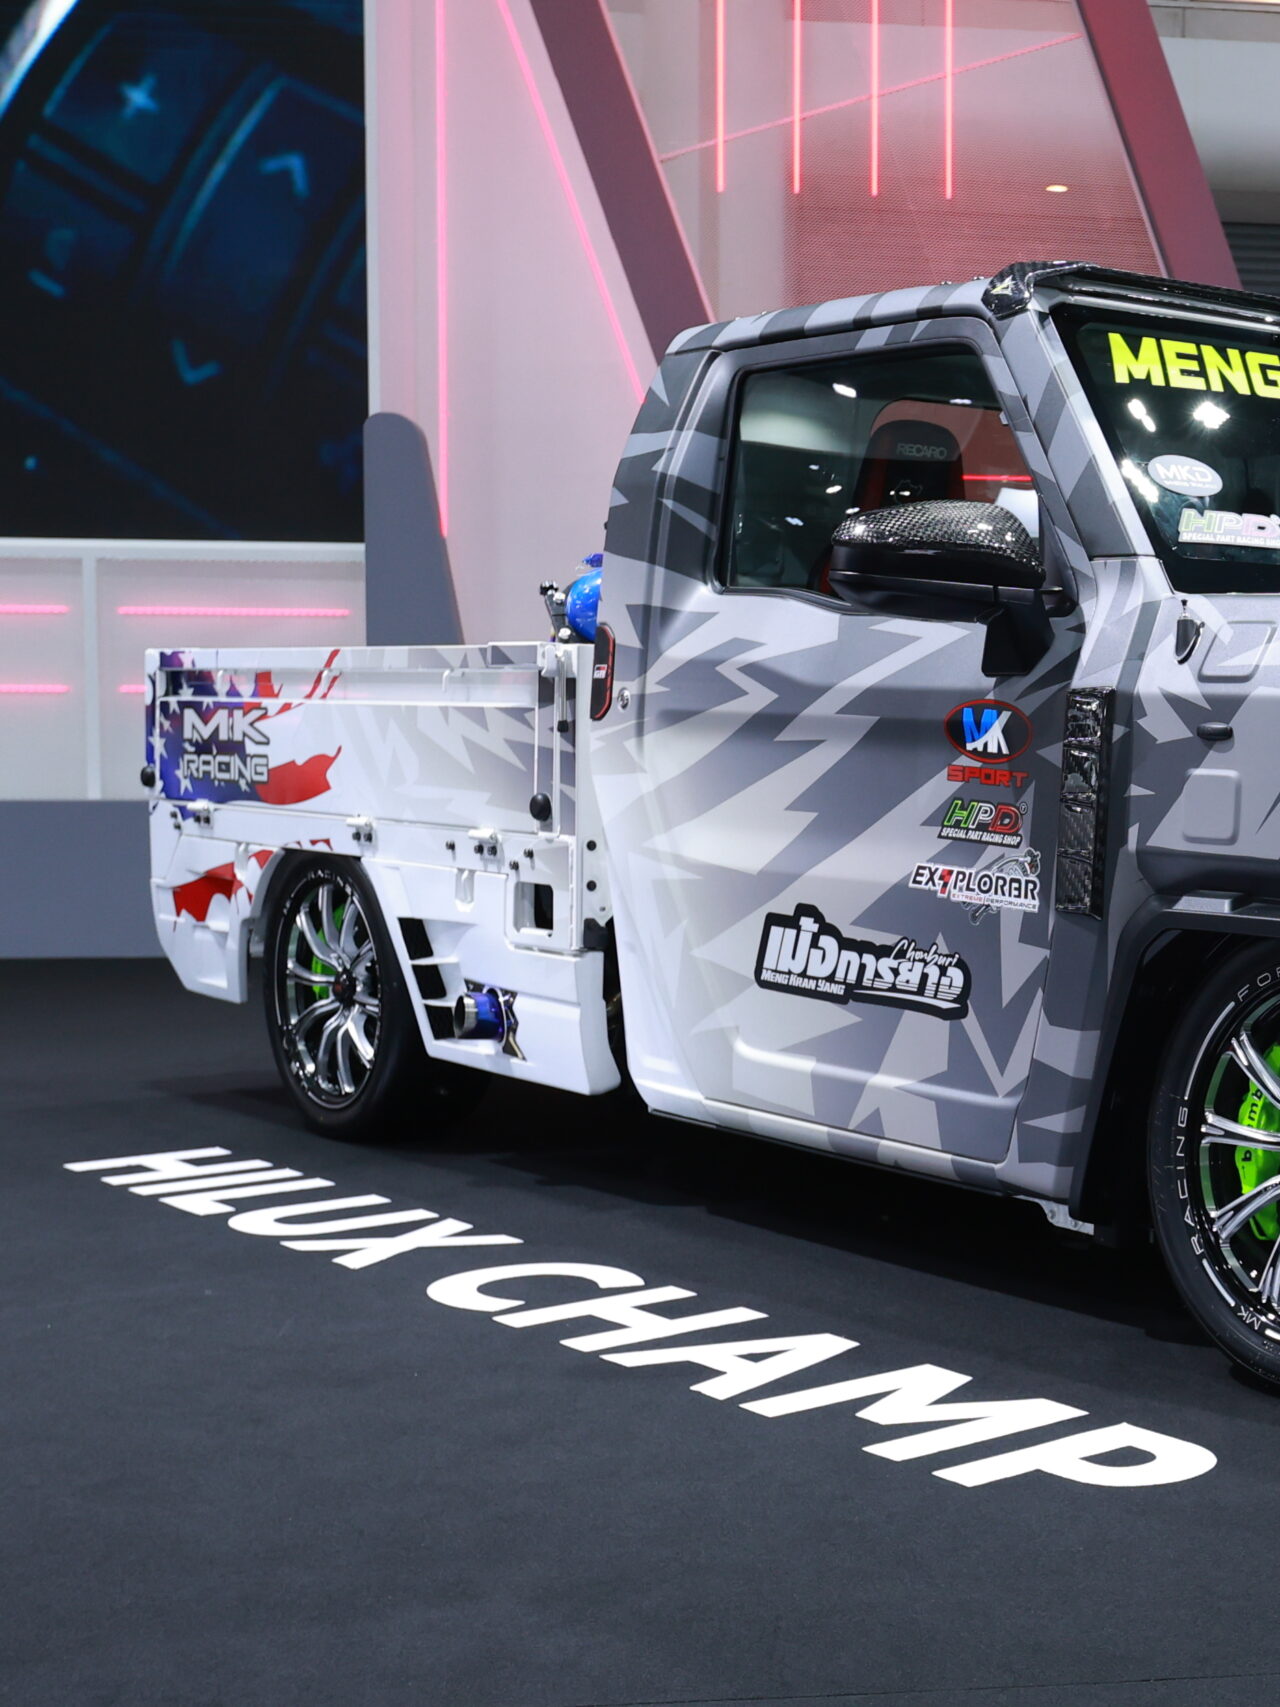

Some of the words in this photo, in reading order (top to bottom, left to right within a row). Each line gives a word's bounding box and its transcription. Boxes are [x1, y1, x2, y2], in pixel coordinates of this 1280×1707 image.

[896, 443, 947, 460] RECARO
[1182, 532, 1216, 541] SPECIAL
[1216, 534, 1237, 543] PART
[1236, 536, 1266, 546] RACING
[183, 707, 270, 745] MK
[962, 707, 1013, 755] MK
[183, 753, 269, 784] RACING
[947, 765, 1029, 788] SPORT
[943, 799, 1023, 834] HPD
[941, 827, 967, 838] SPECIAL
[967, 830, 983, 840] PART
[982, 832, 1003, 844] RACING
[1003, 835, 1021, 846] SHOP
[952, 893, 983, 903] EXTREME
[985, 898, 1037, 910] PERFORMANCE
[891, 938, 961, 967] Chonburi
[1176, 1106, 1205, 1256] RACING
[62, 1146, 525, 1271] HILUX
[426, 1261, 1219, 1488] CHAMP
[1237, 1305, 1262, 1330] MK
